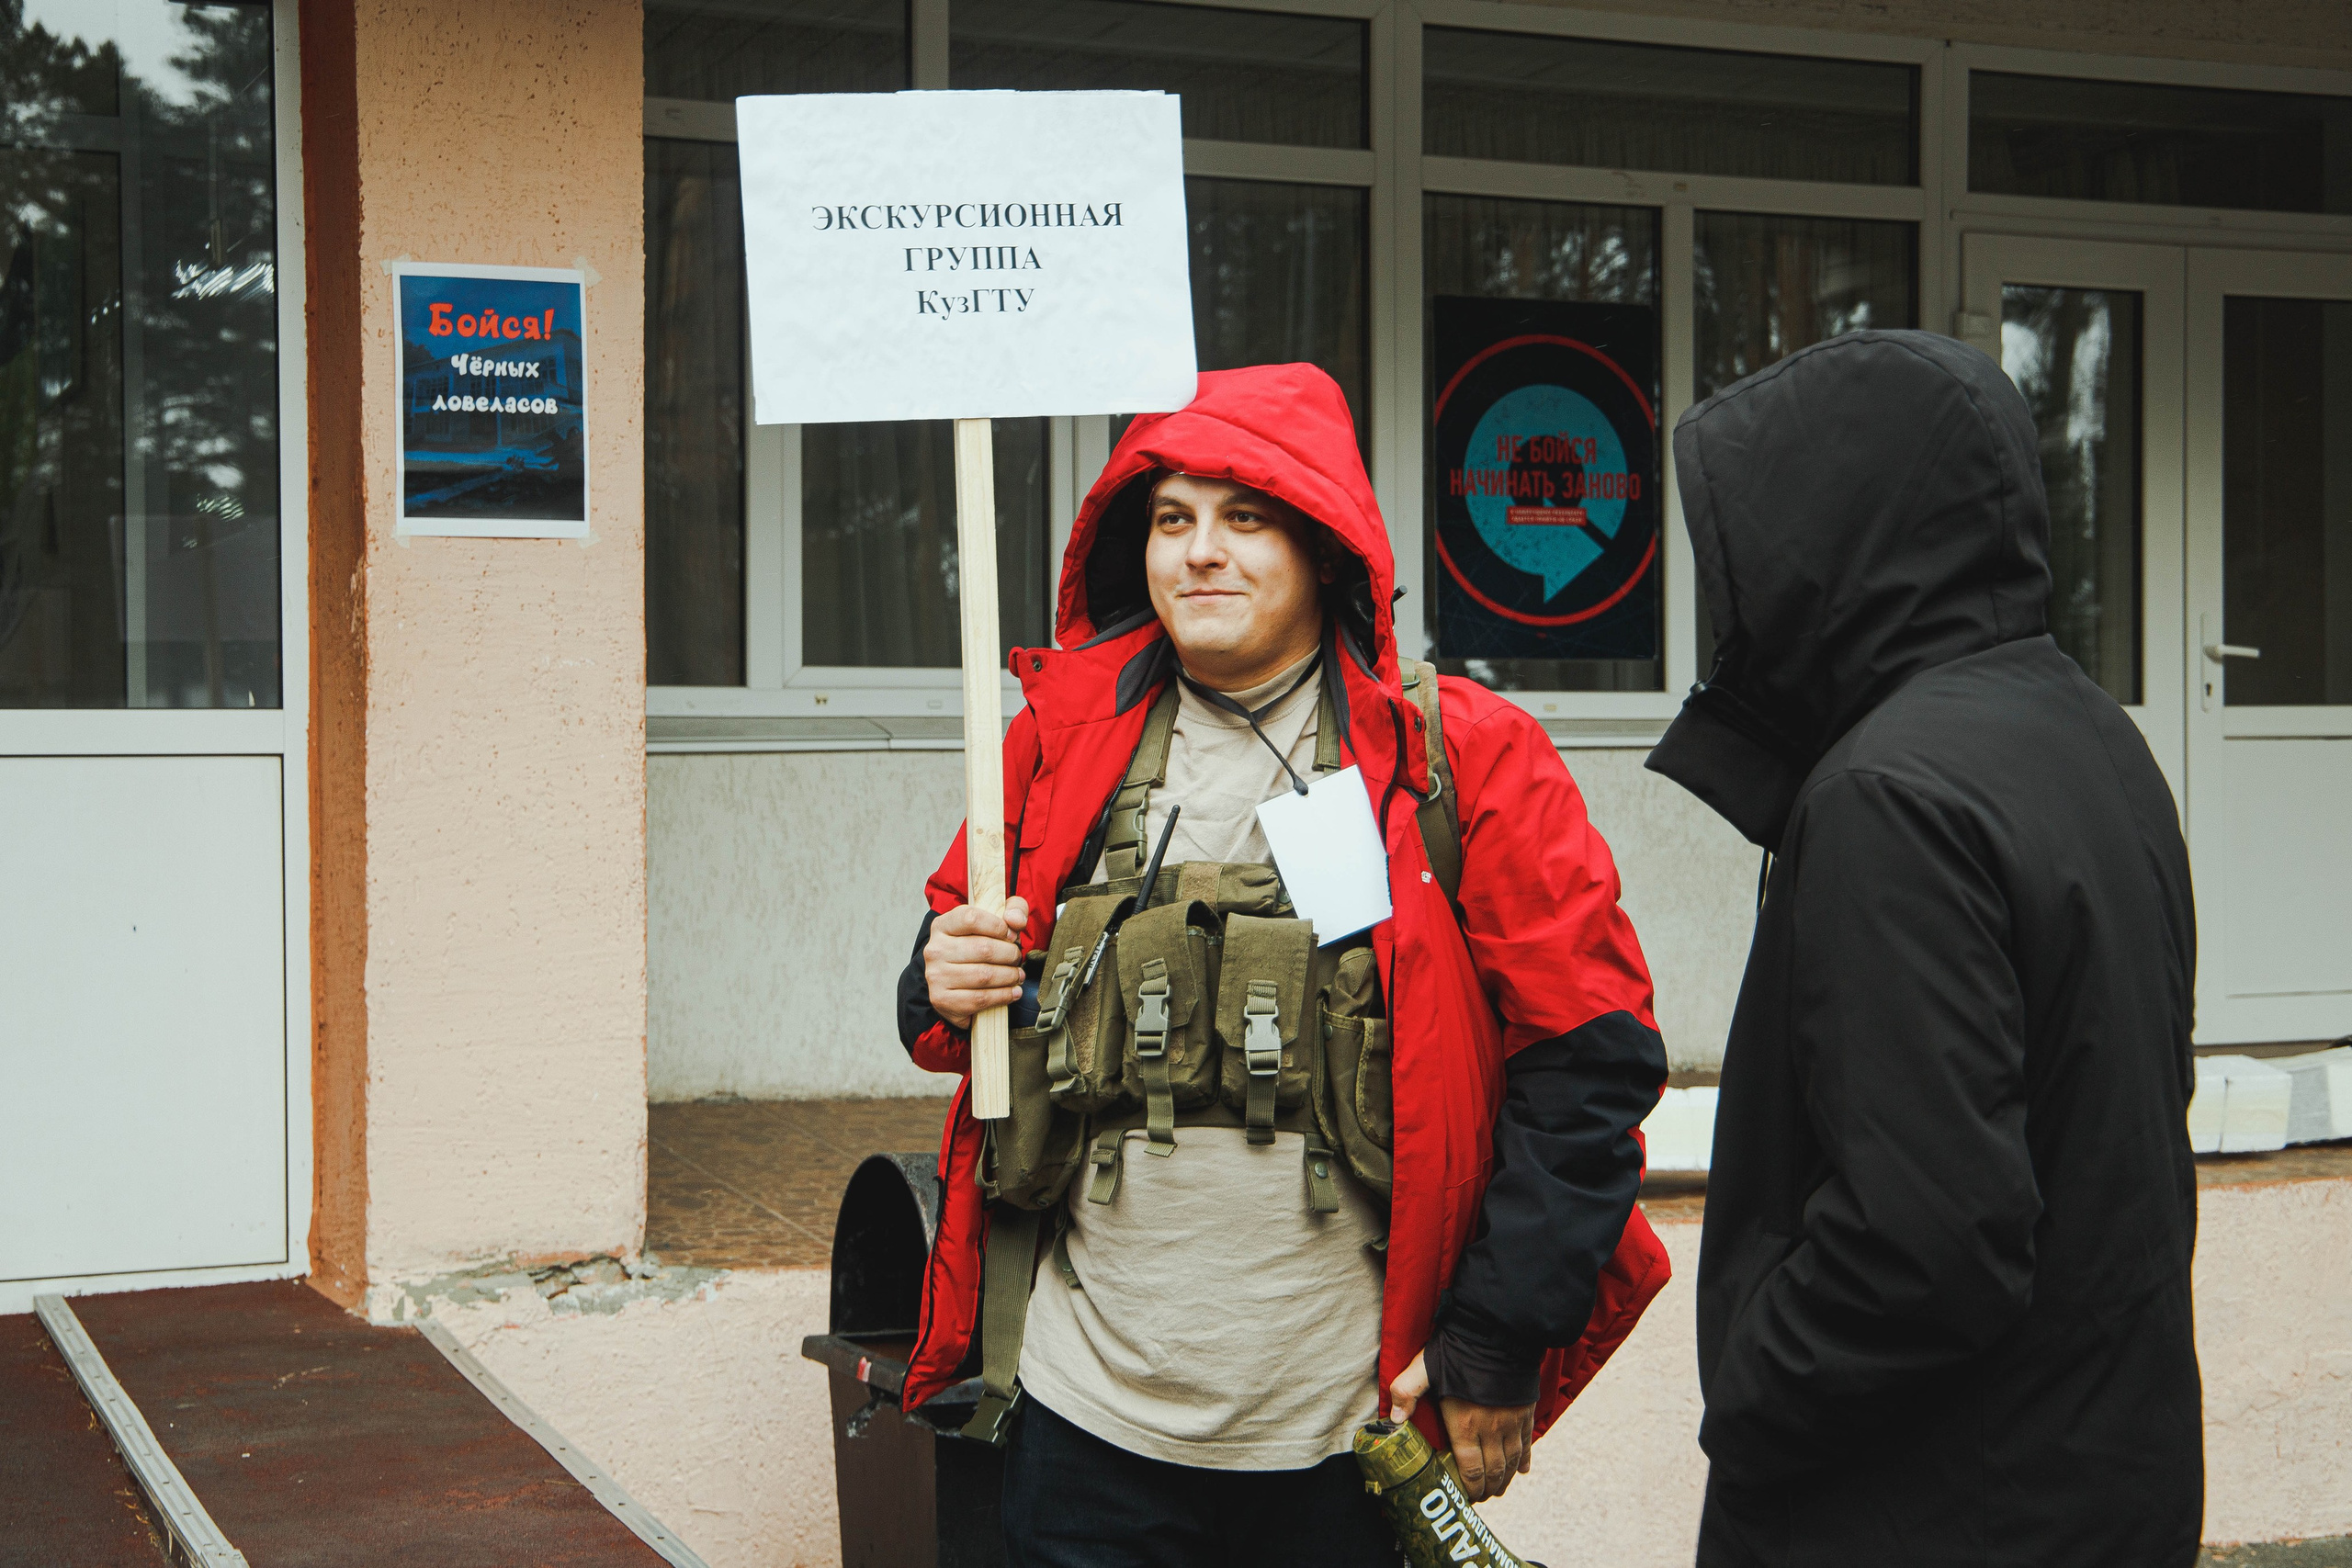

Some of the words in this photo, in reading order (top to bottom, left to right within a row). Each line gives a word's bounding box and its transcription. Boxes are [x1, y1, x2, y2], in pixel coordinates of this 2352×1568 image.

[811, 202, 1124, 231] ЭКСКУРСИОННАЯ
[904, 245, 1043, 272] ГРУППА
[916, 288, 1035, 320] КузГТУ
[428, 302, 555, 341] Бойся!
[451, 354, 539, 378] Чёрных
[432, 394, 559, 414] ловеласов
[1496, 435, 1523, 463] НЕ
[1530, 430, 1597, 465] БОЙСЯ
[1450, 468, 1555, 499] НАЧИНАТЬ
[1561, 471, 1642, 501] ЗАНОВО
